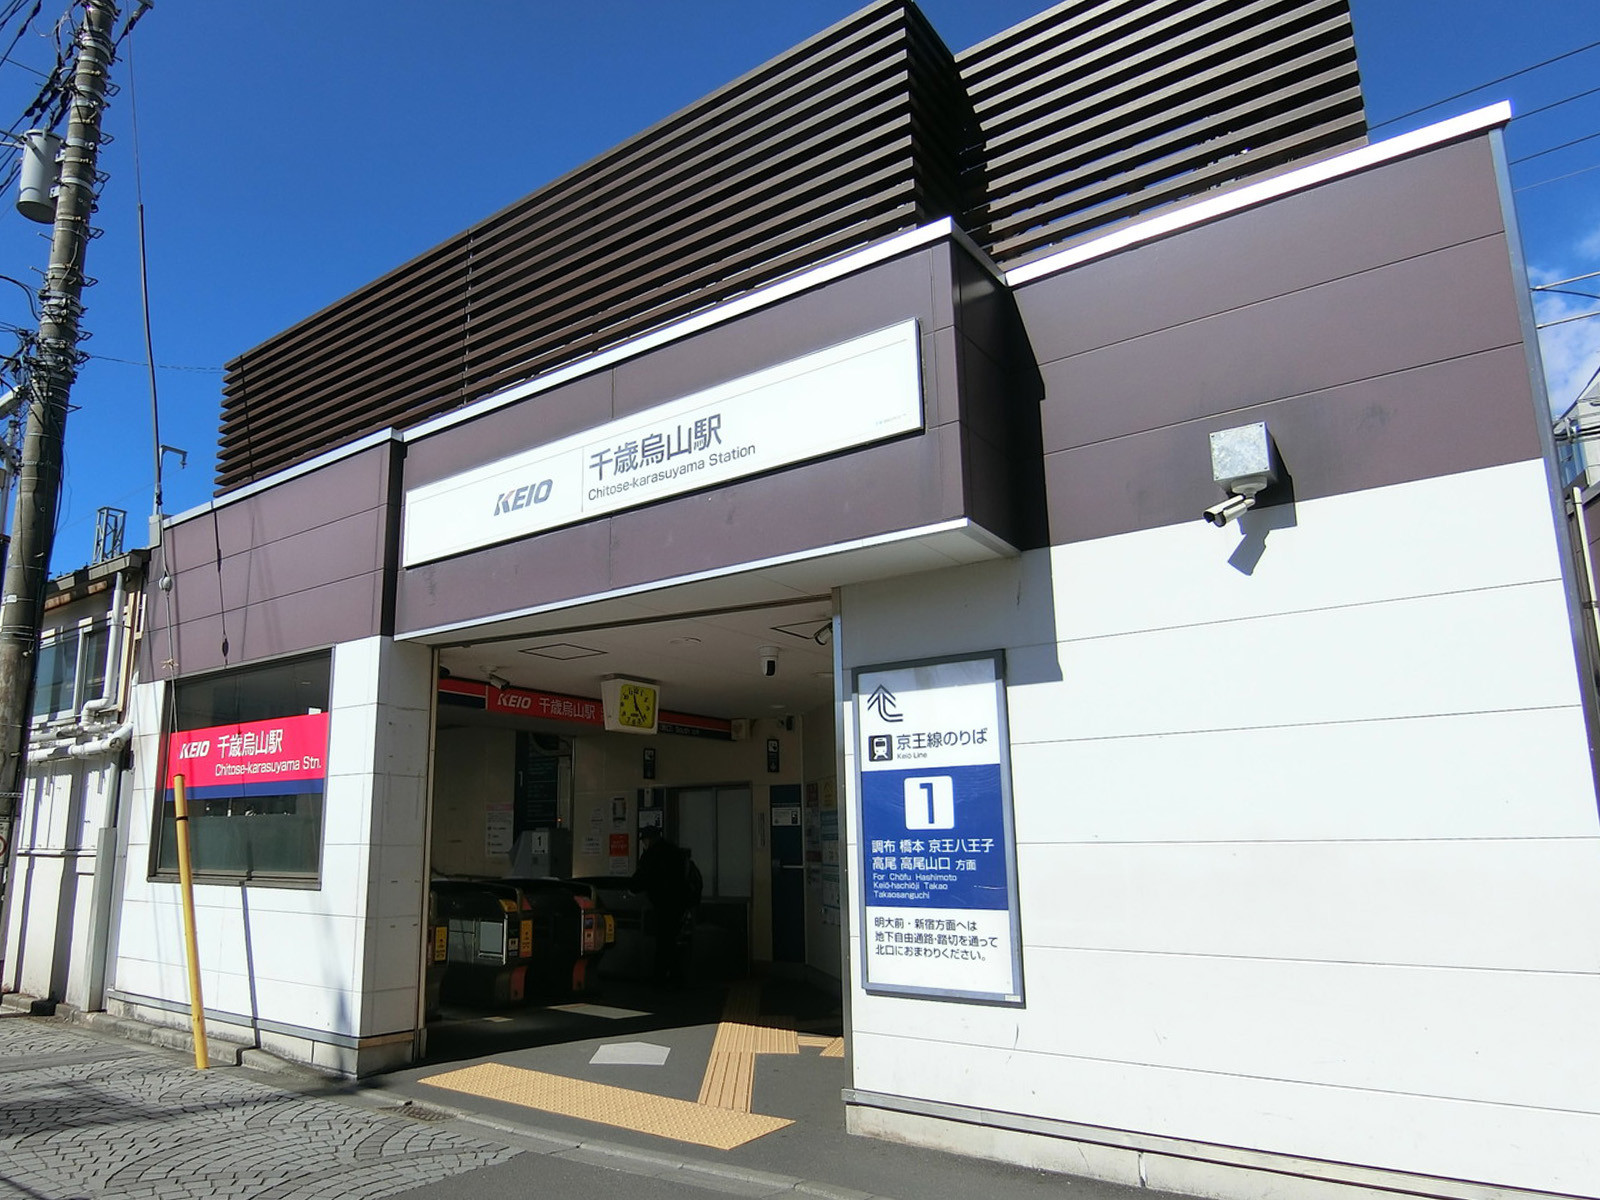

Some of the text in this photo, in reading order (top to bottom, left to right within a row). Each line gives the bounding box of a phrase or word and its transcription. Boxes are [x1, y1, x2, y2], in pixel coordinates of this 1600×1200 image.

[588, 413, 723, 481] 千歳烏山駅
[588, 442, 756, 501] Chitose-karasuyama Station
[494, 478, 554, 516] KEIO
[497, 692, 532, 709] KEIO
[538, 697, 596, 720] 千歳烏山駅
[217, 729, 284, 759] 千歳烏山駅
[896, 728, 988, 750] 京王線のりば
[179, 740, 211, 760] KEIO
[215, 755, 322, 777] Chitose-karasuyama Stn.
[919, 782, 935, 825] 1
[871, 838, 995, 854] 調布 橋本 京王八王子
[872, 856, 977, 871] 高尾 高尾山口 方面
[873, 873, 885, 881] For
[916, 873, 958, 881] Hashimoto
[924, 882, 949, 891] Takao
[873, 891, 930, 900] Takaosanguchi
[875, 945, 986, 962] 北口におまわりください。
